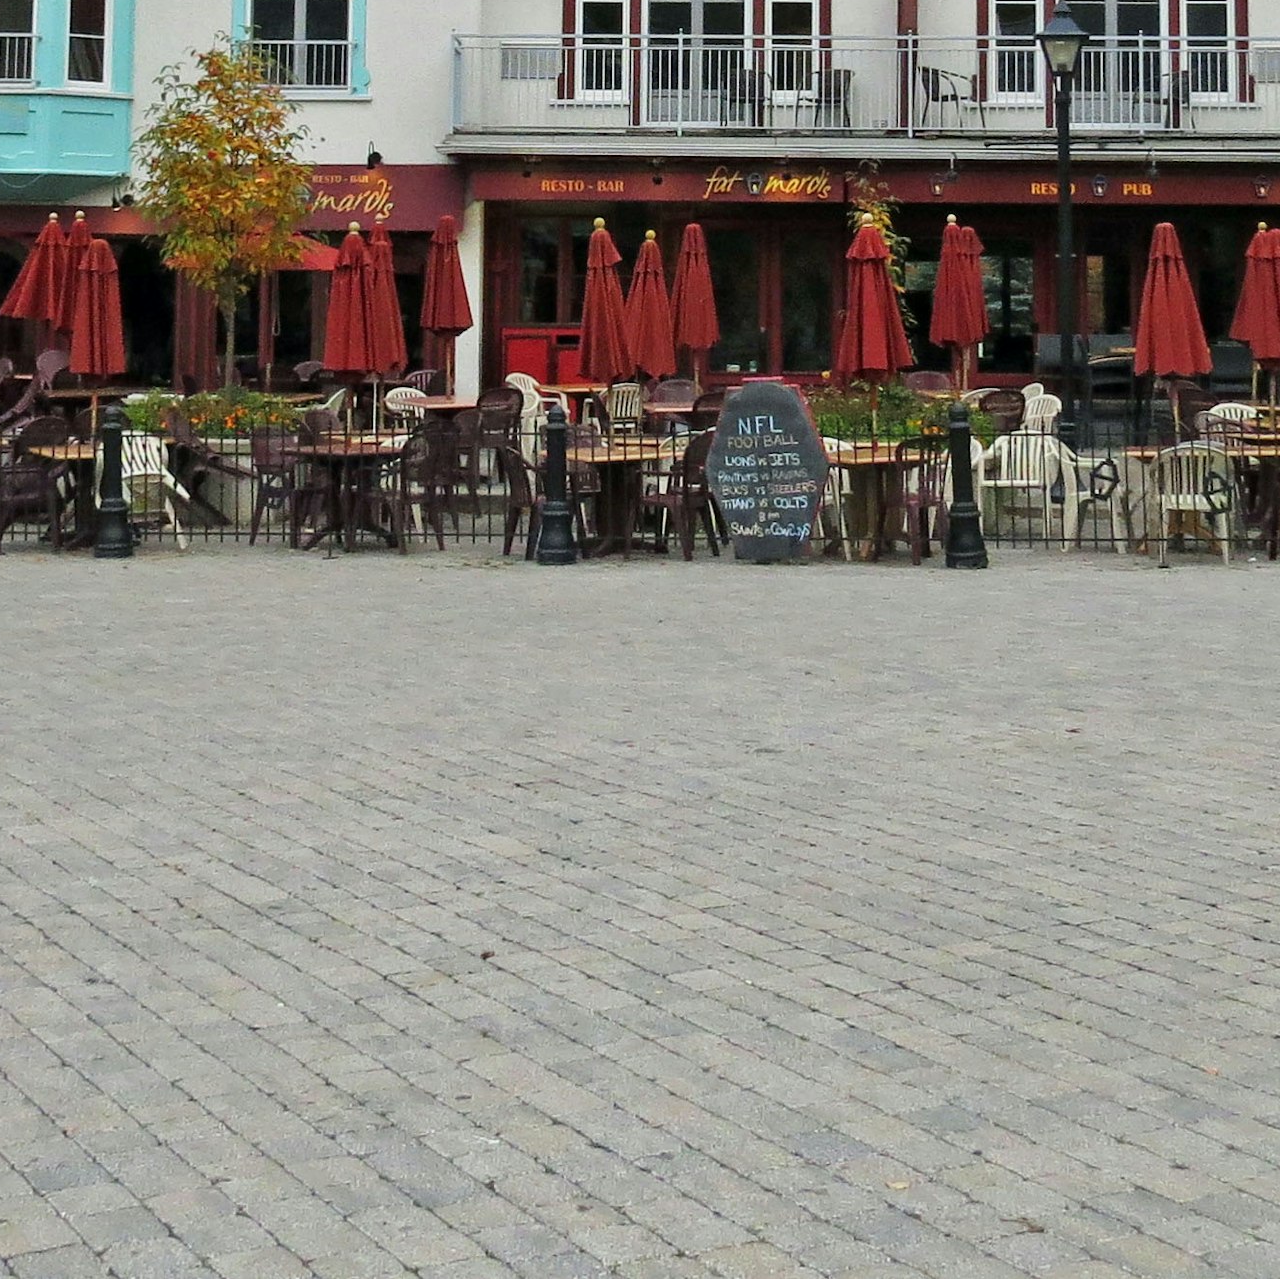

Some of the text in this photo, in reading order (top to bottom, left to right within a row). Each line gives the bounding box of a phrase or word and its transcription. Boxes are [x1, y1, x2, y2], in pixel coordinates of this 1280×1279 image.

[312, 175, 342, 183] RESTO
[350, 175, 369, 183] BAR
[703, 166, 831, 199] fat mardis
[541, 180, 584, 192] RESTO
[596, 180, 624, 192] BAR
[1031, 183, 1152, 195] RES PUB
[738, 415, 783, 435] NFL
[768, 453, 800, 466] JETS
[773, 495, 808, 509] COLTS
